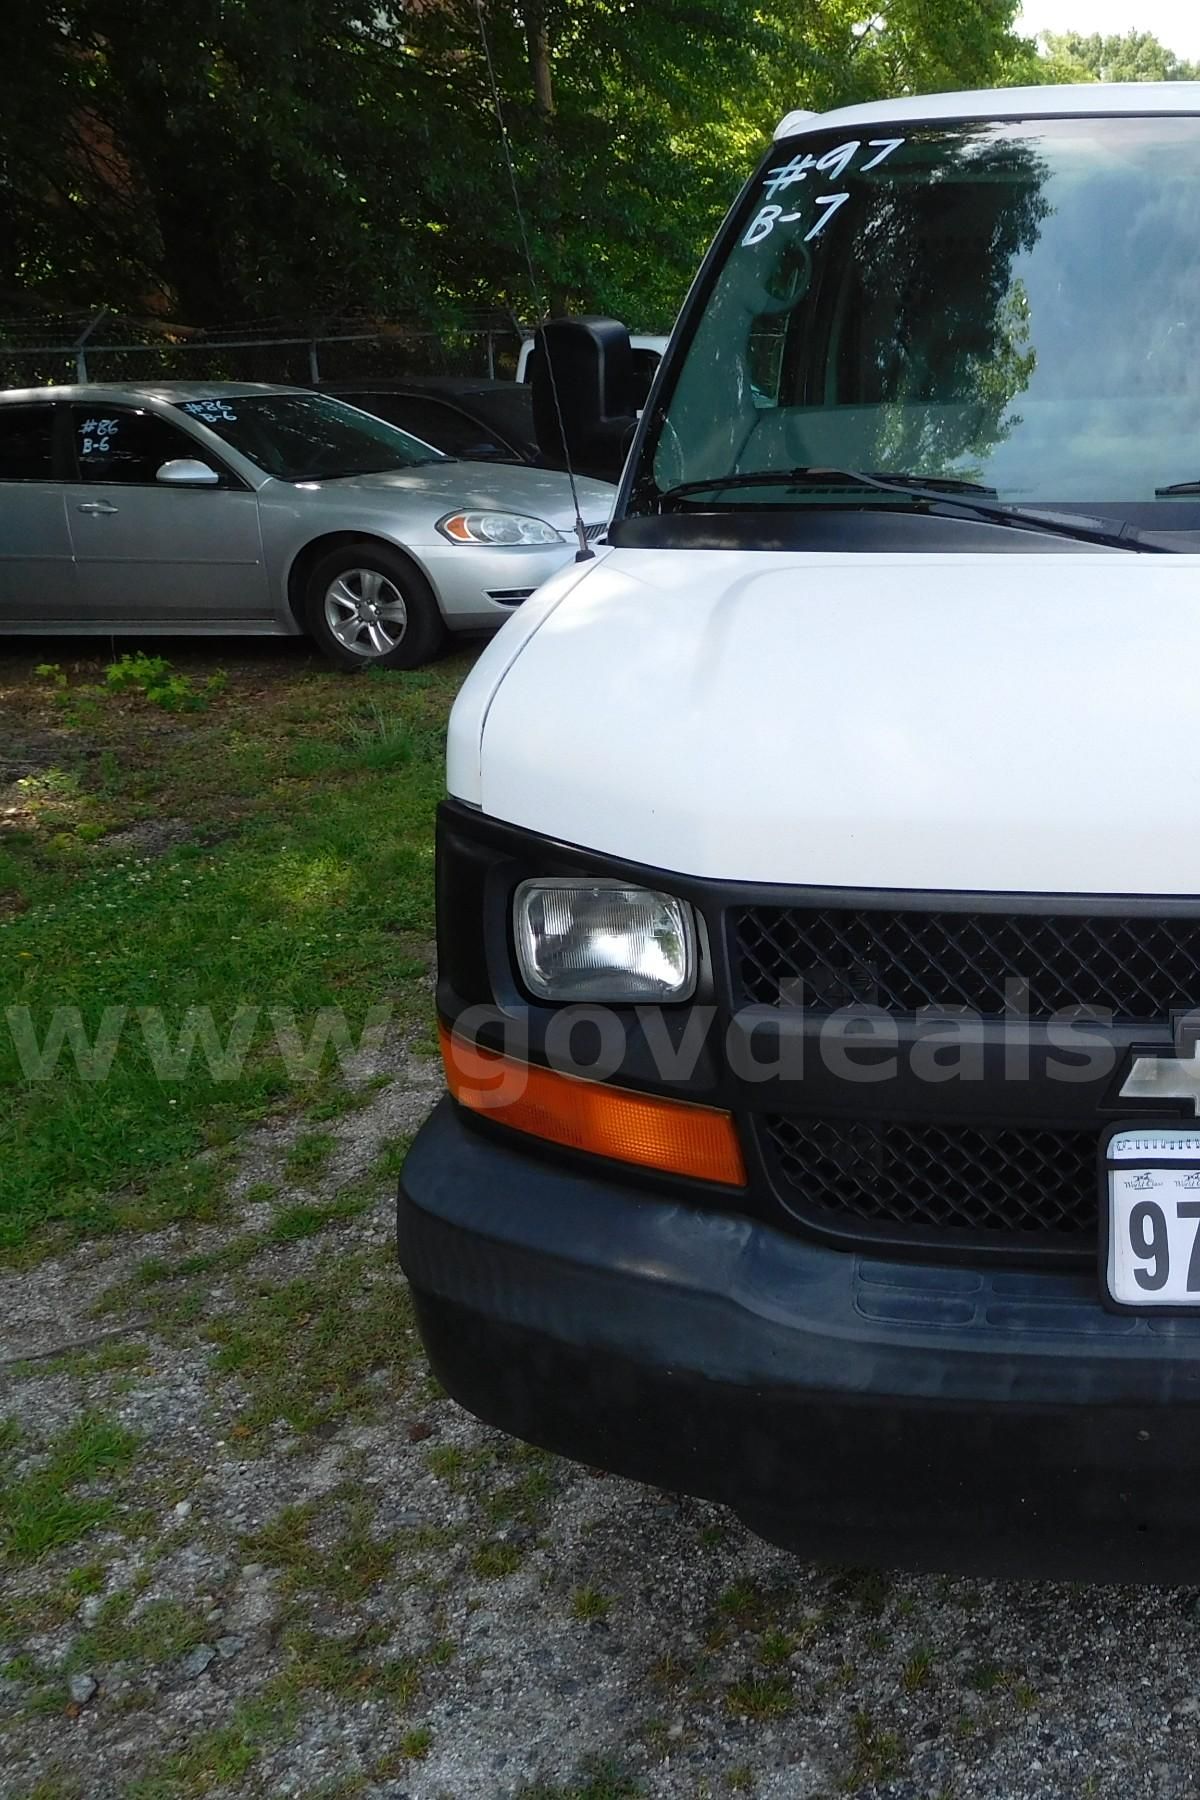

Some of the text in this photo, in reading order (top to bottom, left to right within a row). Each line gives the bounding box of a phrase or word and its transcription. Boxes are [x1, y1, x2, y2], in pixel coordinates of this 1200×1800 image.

[763, 138, 906, 200] #97
[741, 192, 850, 247] B-7
[184, 400, 233, 414] #86
[199, 410, 238, 424] B-6
[78, 418, 120, 436] #86
[82, 436, 110, 454] B-6
